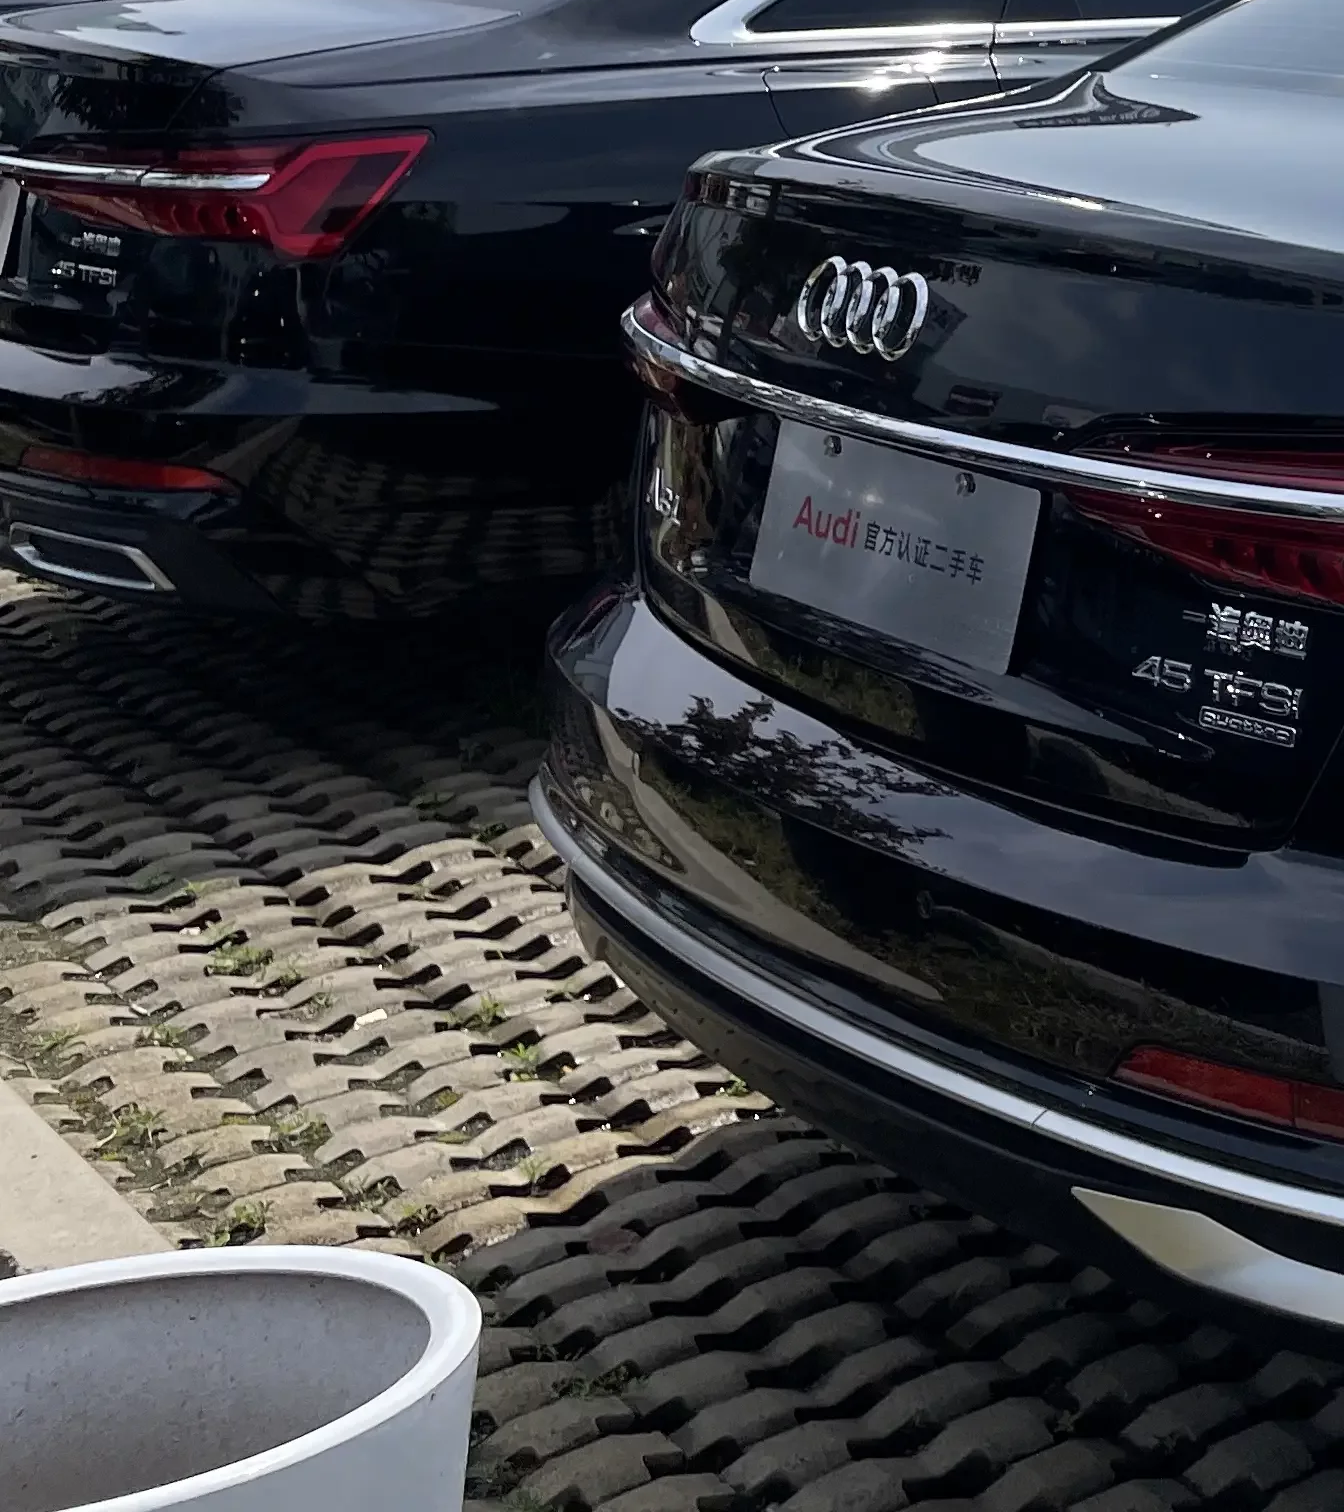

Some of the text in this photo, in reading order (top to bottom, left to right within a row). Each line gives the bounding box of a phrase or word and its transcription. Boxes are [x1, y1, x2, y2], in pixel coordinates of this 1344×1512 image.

[78, 264, 117, 288] TFSI
[793, 495, 985, 585] Audi 官方认证二手车
[1131, 655, 1304, 720] 45 TFSI
